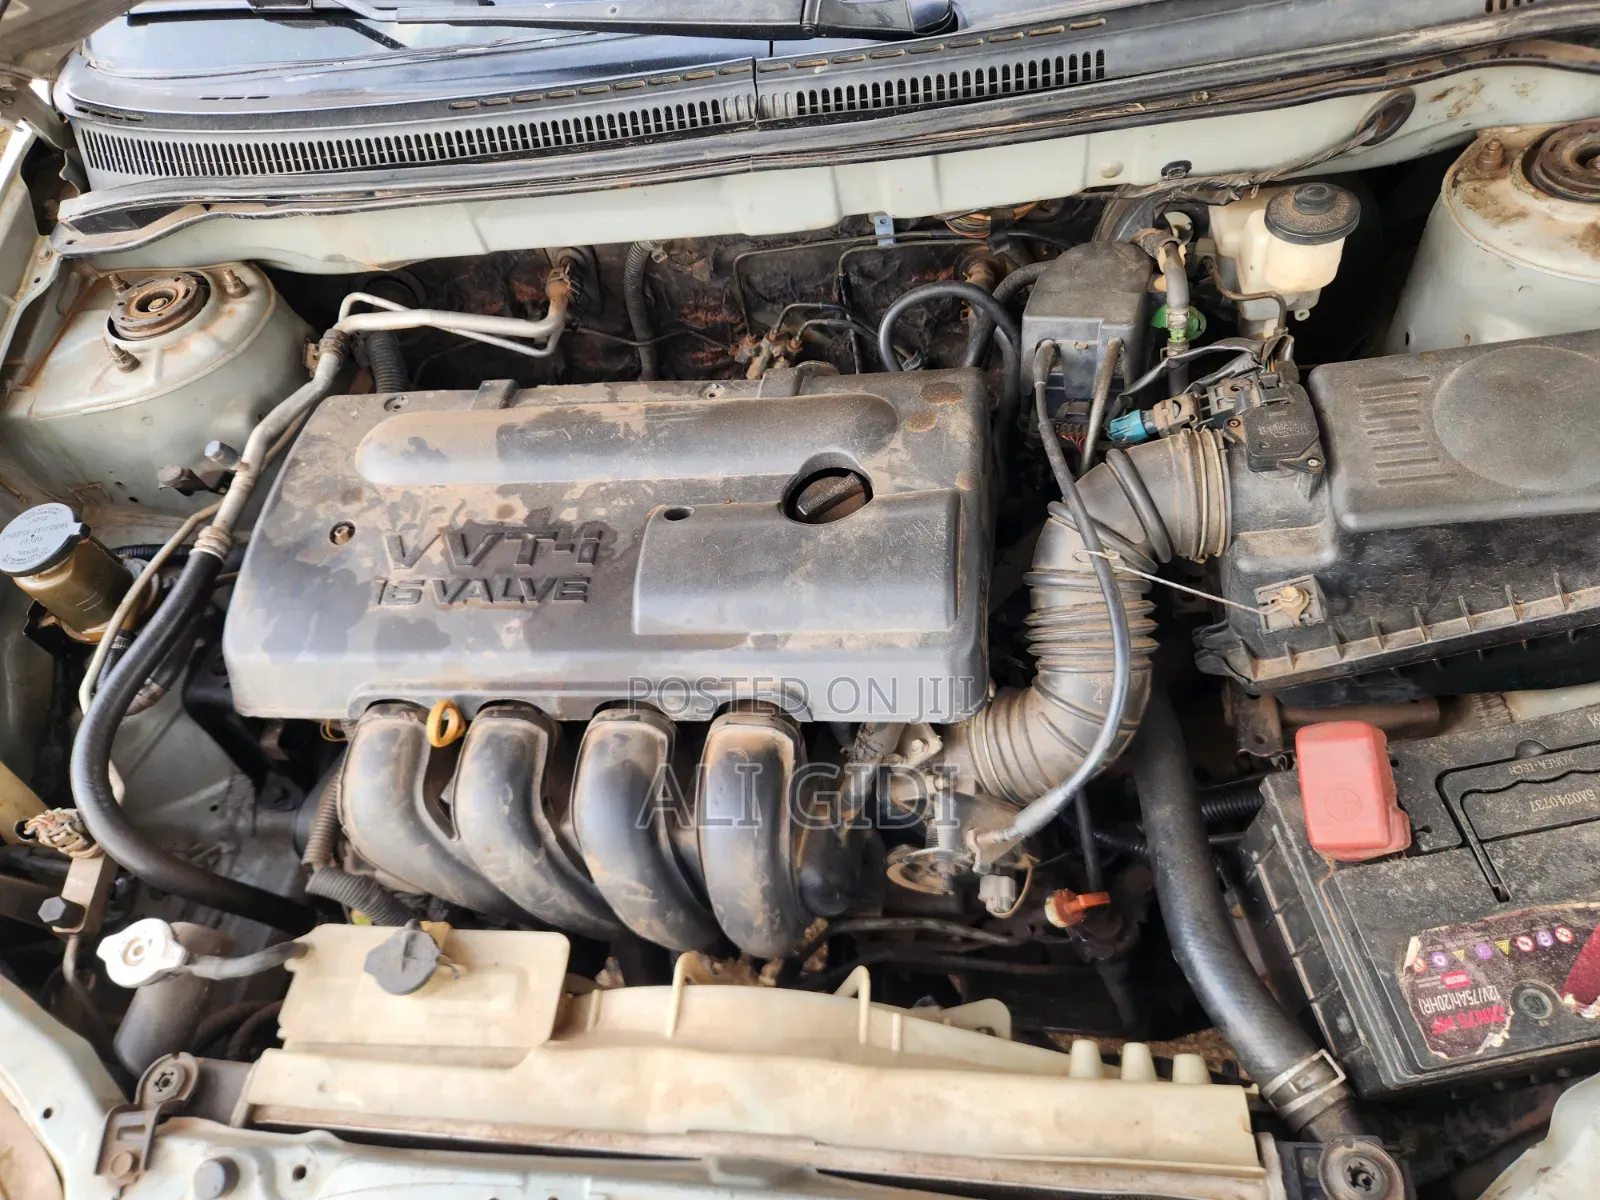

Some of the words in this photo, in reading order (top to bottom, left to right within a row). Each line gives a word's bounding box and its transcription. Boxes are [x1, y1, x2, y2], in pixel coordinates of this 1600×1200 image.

[368, 578, 426, 606] 16
[431, 576, 592, 605] VALVE
[1529, 788, 1597, 812] 5A0340737
[1418, 984, 1502, 1015] 12V/75Ah(20HR)
